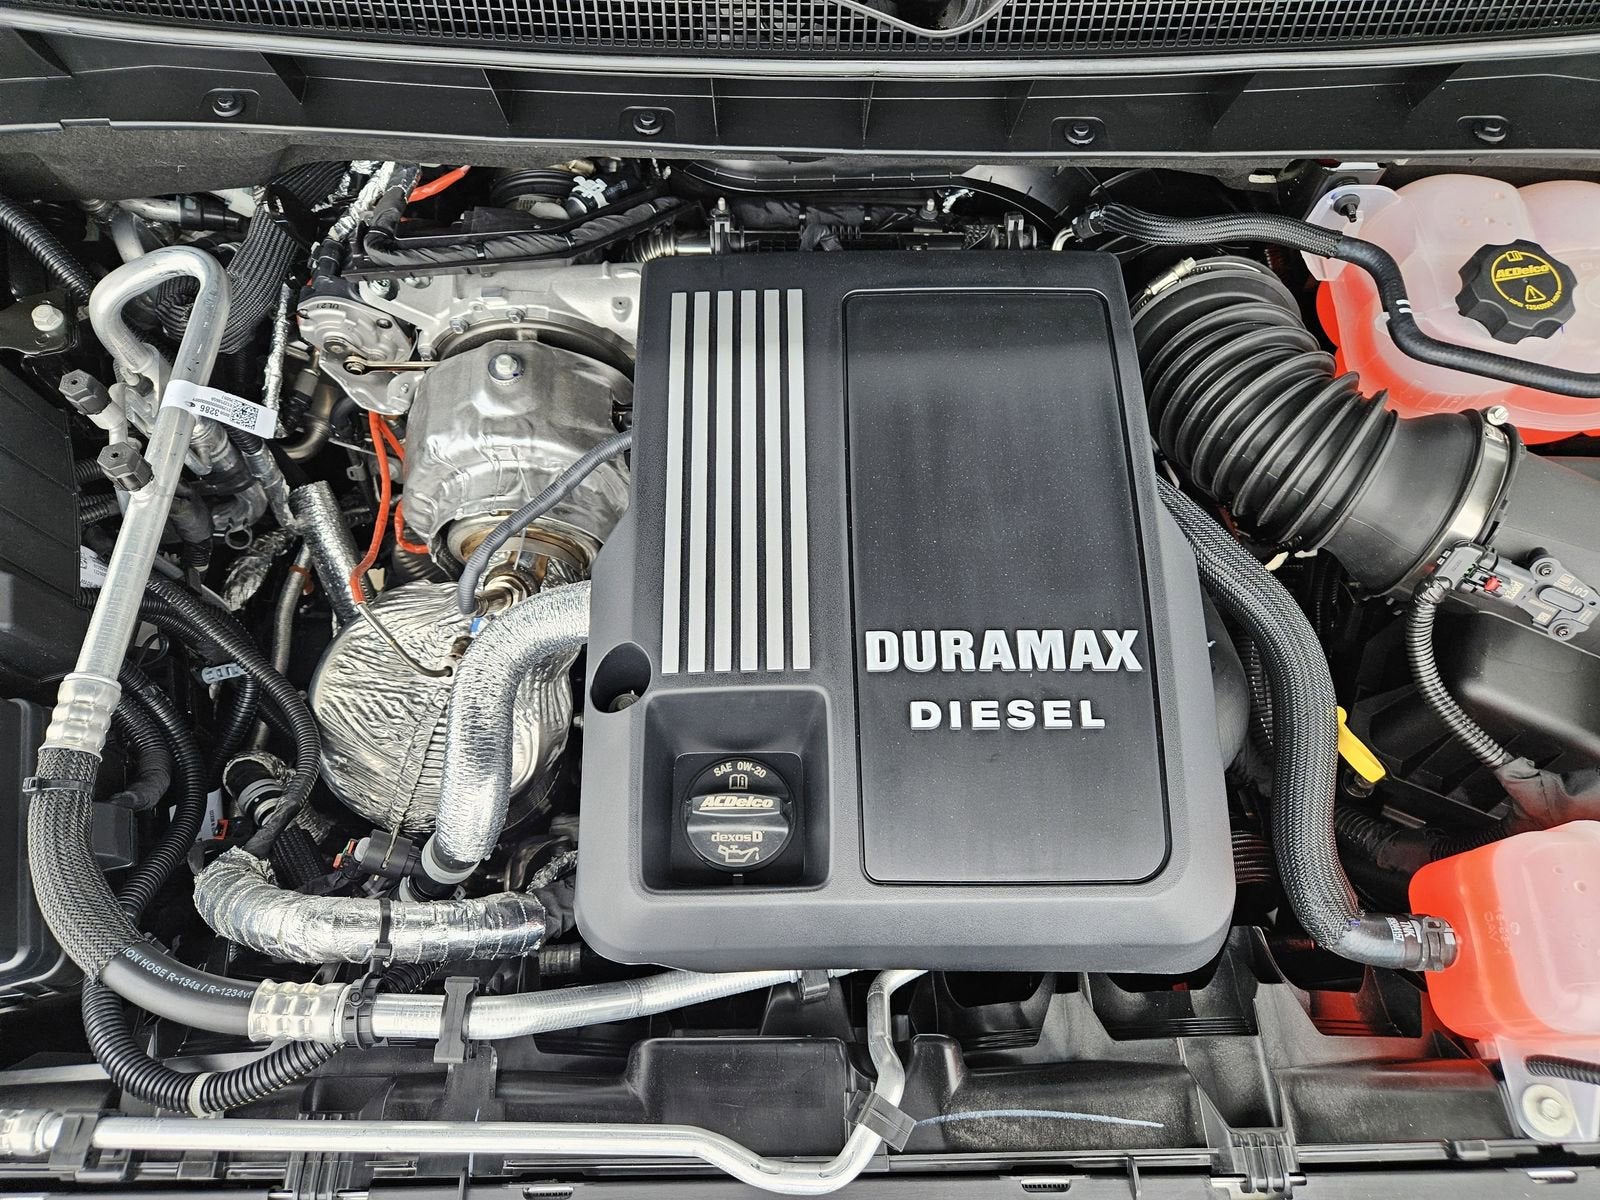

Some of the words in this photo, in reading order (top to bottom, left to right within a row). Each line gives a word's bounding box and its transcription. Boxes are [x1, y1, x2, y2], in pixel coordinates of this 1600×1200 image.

[1495, 264, 1550, 280] ACDelco
[865, 629, 1143, 673] DURAMAX
[909, 699, 1106, 730] DIESEL
[713, 762, 733, 777] SAE
[737, 761, 767, 779] 0W-20
[700, 796, 775, 810] ACDelco
[139, 959, 168, 978] HOSE
[166, 972, 200, 991] R-134a
